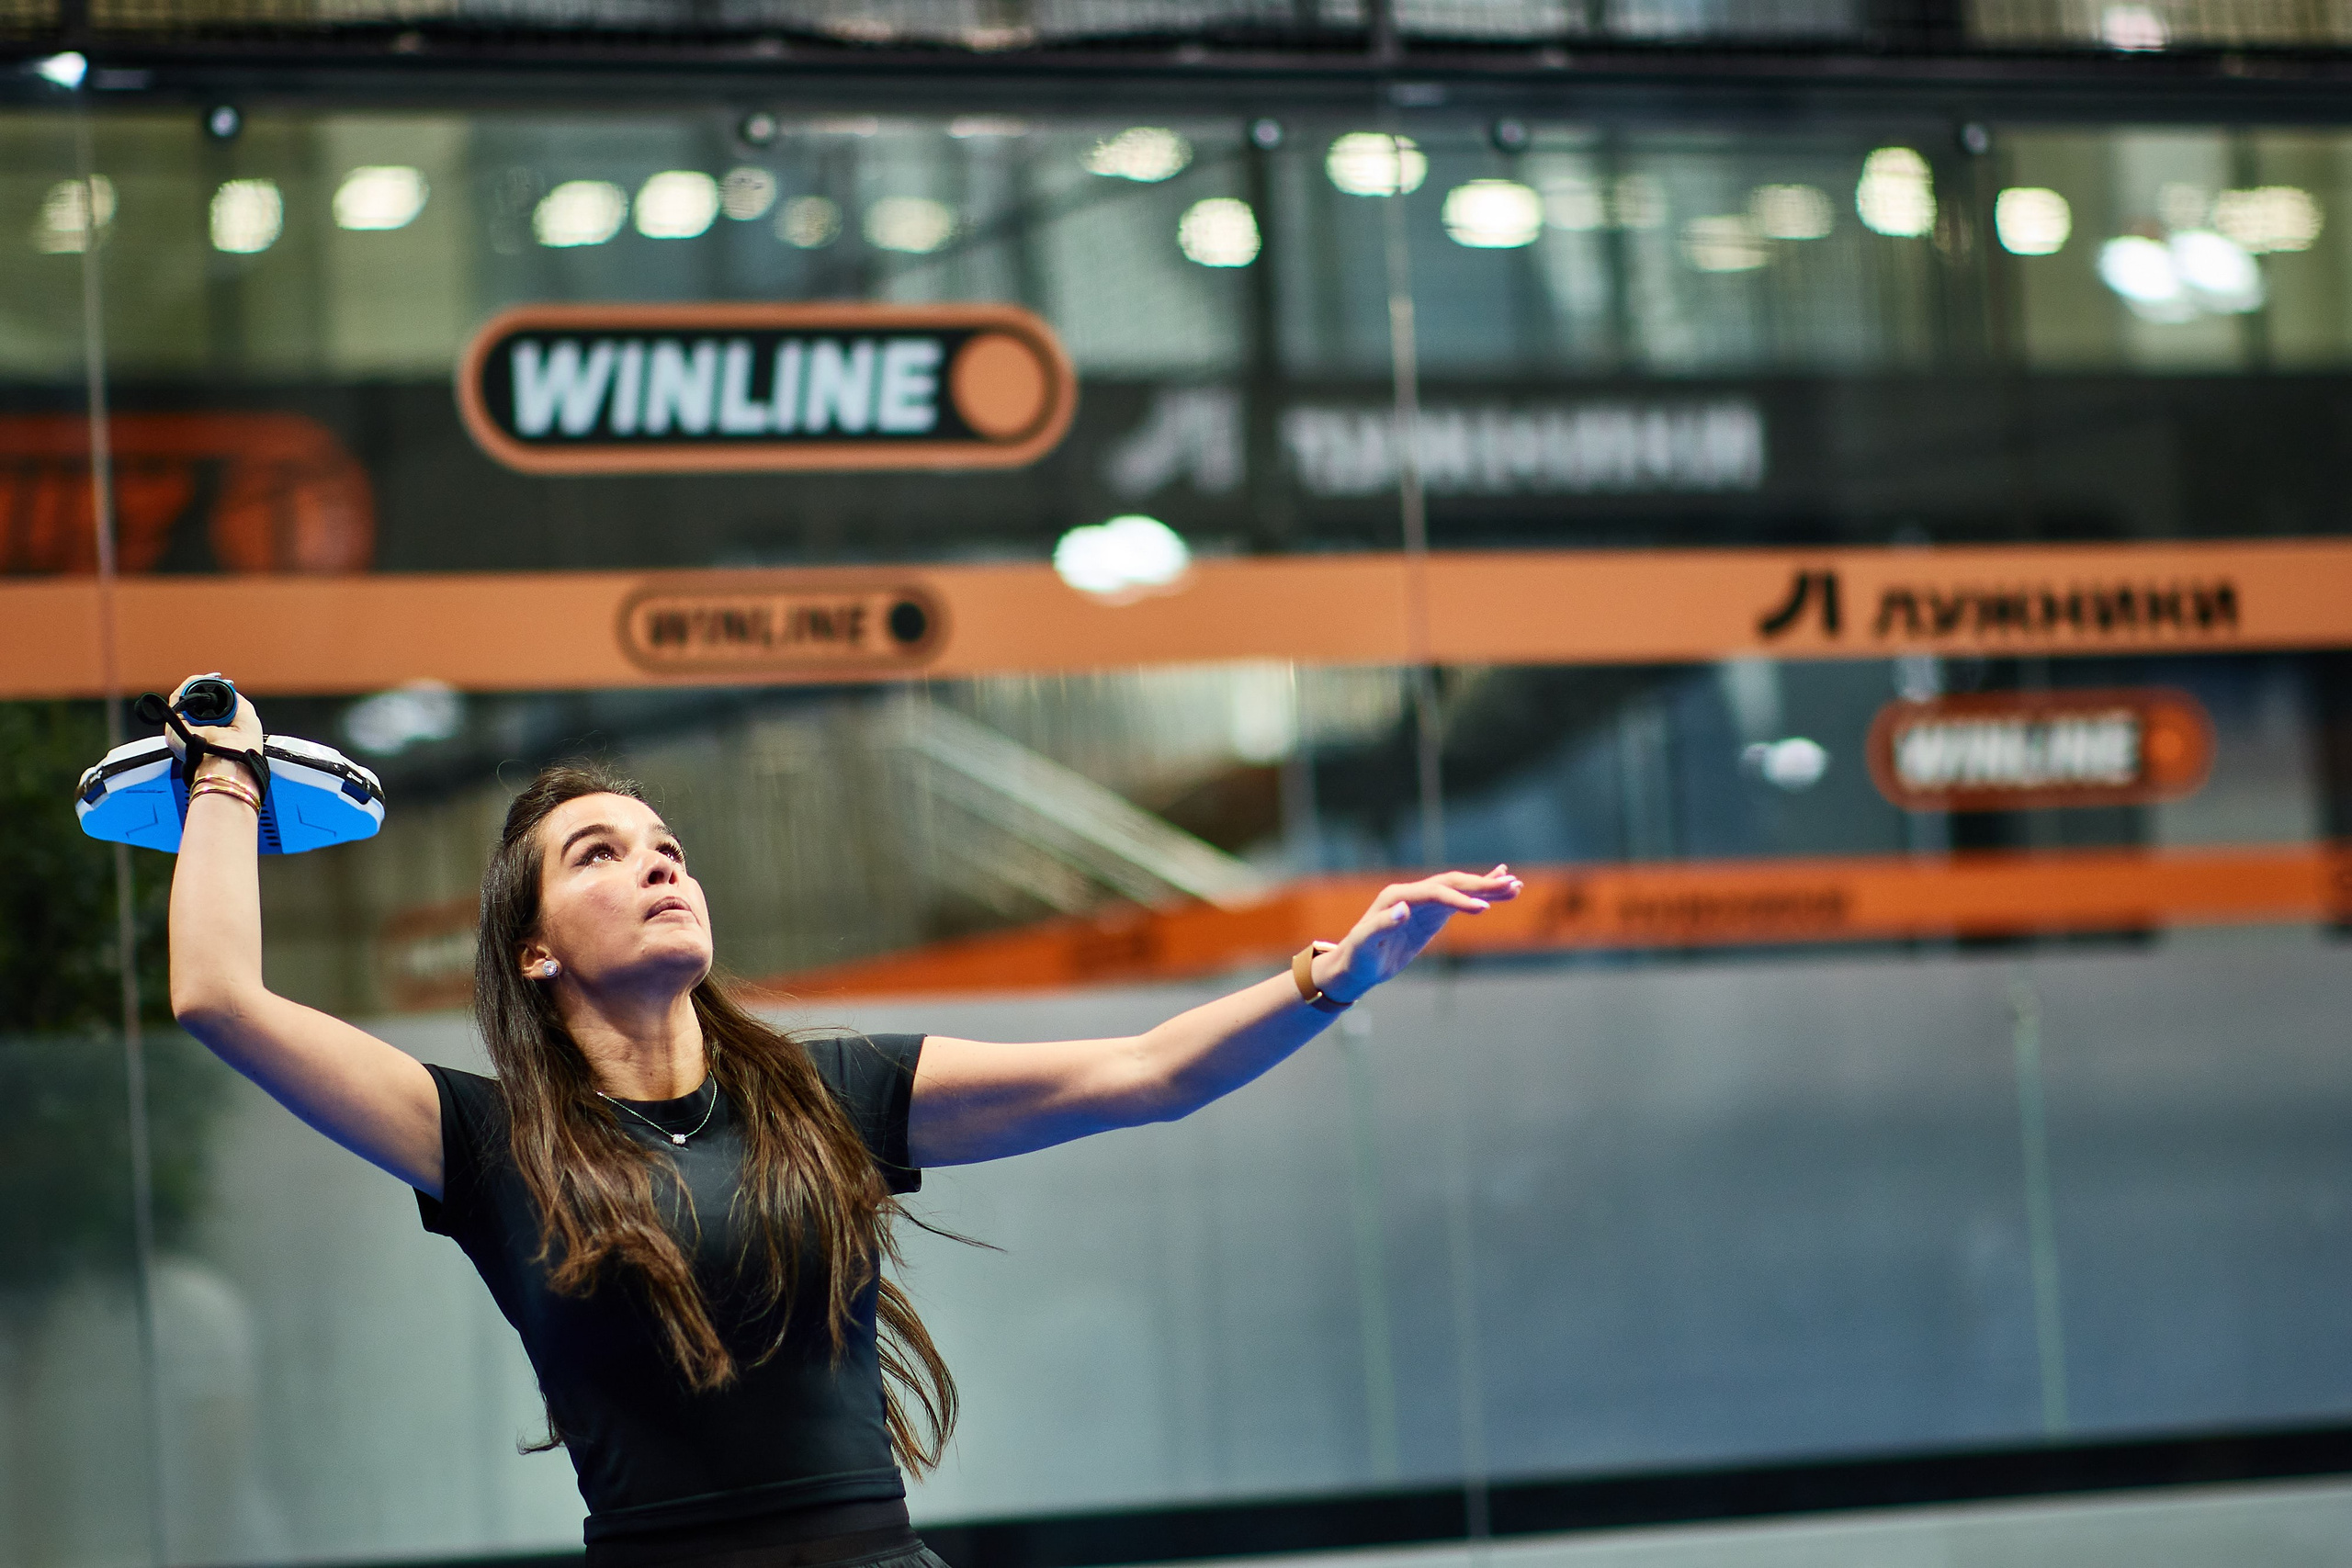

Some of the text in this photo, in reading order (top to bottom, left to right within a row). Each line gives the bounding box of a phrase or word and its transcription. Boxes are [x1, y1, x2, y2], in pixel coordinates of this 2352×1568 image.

[511, 340, 944, 437] WINLINE
[648, 603, 871, 649] WINLINE
[1877, 581, 2240, 636] ЛУЖНИКИ
